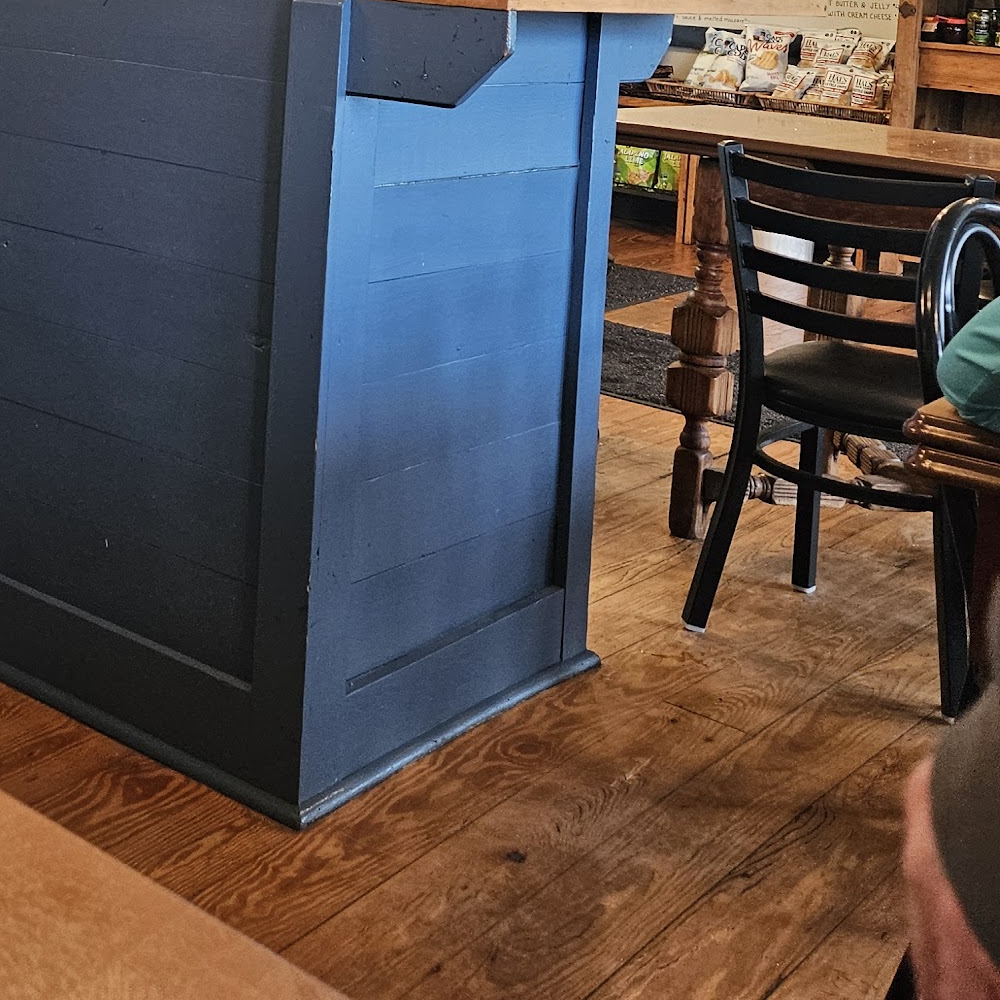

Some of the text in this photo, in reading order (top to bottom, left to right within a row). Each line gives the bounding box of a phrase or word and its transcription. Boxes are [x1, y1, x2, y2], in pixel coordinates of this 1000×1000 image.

[848, 11, 868, 19] CREAM
[869, 12, 892, 20] CHEESE
[748, 38, 788, 54] Waves
